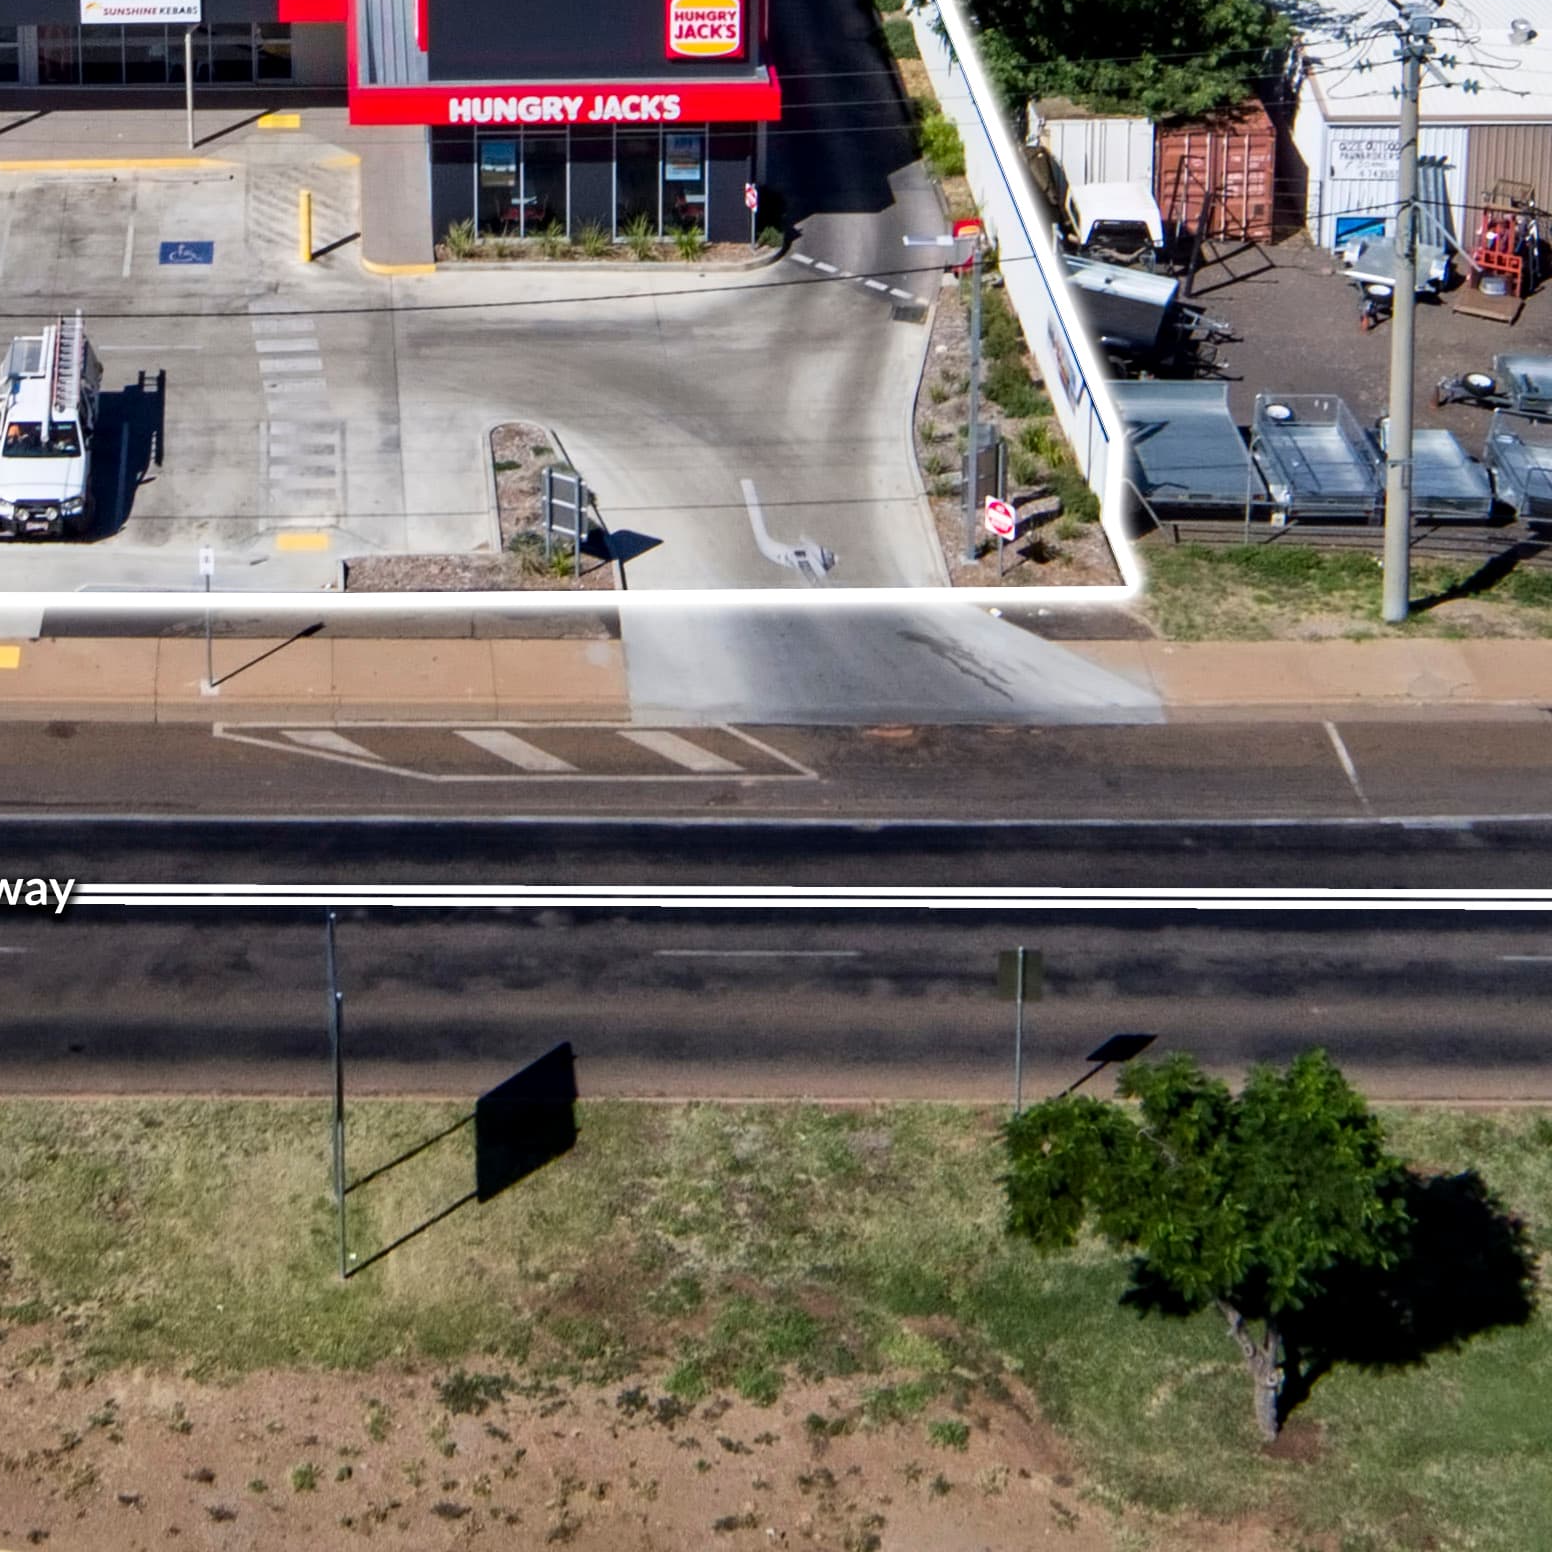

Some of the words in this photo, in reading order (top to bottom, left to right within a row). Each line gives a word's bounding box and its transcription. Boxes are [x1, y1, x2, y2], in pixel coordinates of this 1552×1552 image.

[103, 8, 156, 16] SUNSHINE
[159, 6, 198, 15] KEBABS
[674, 10, 737, 21] HUNGRY
[674, 24, 737, 39] JACK'S
[448, 96, 584, 122] HUNGRY
[588, 94, 681, 121] JACK'S
